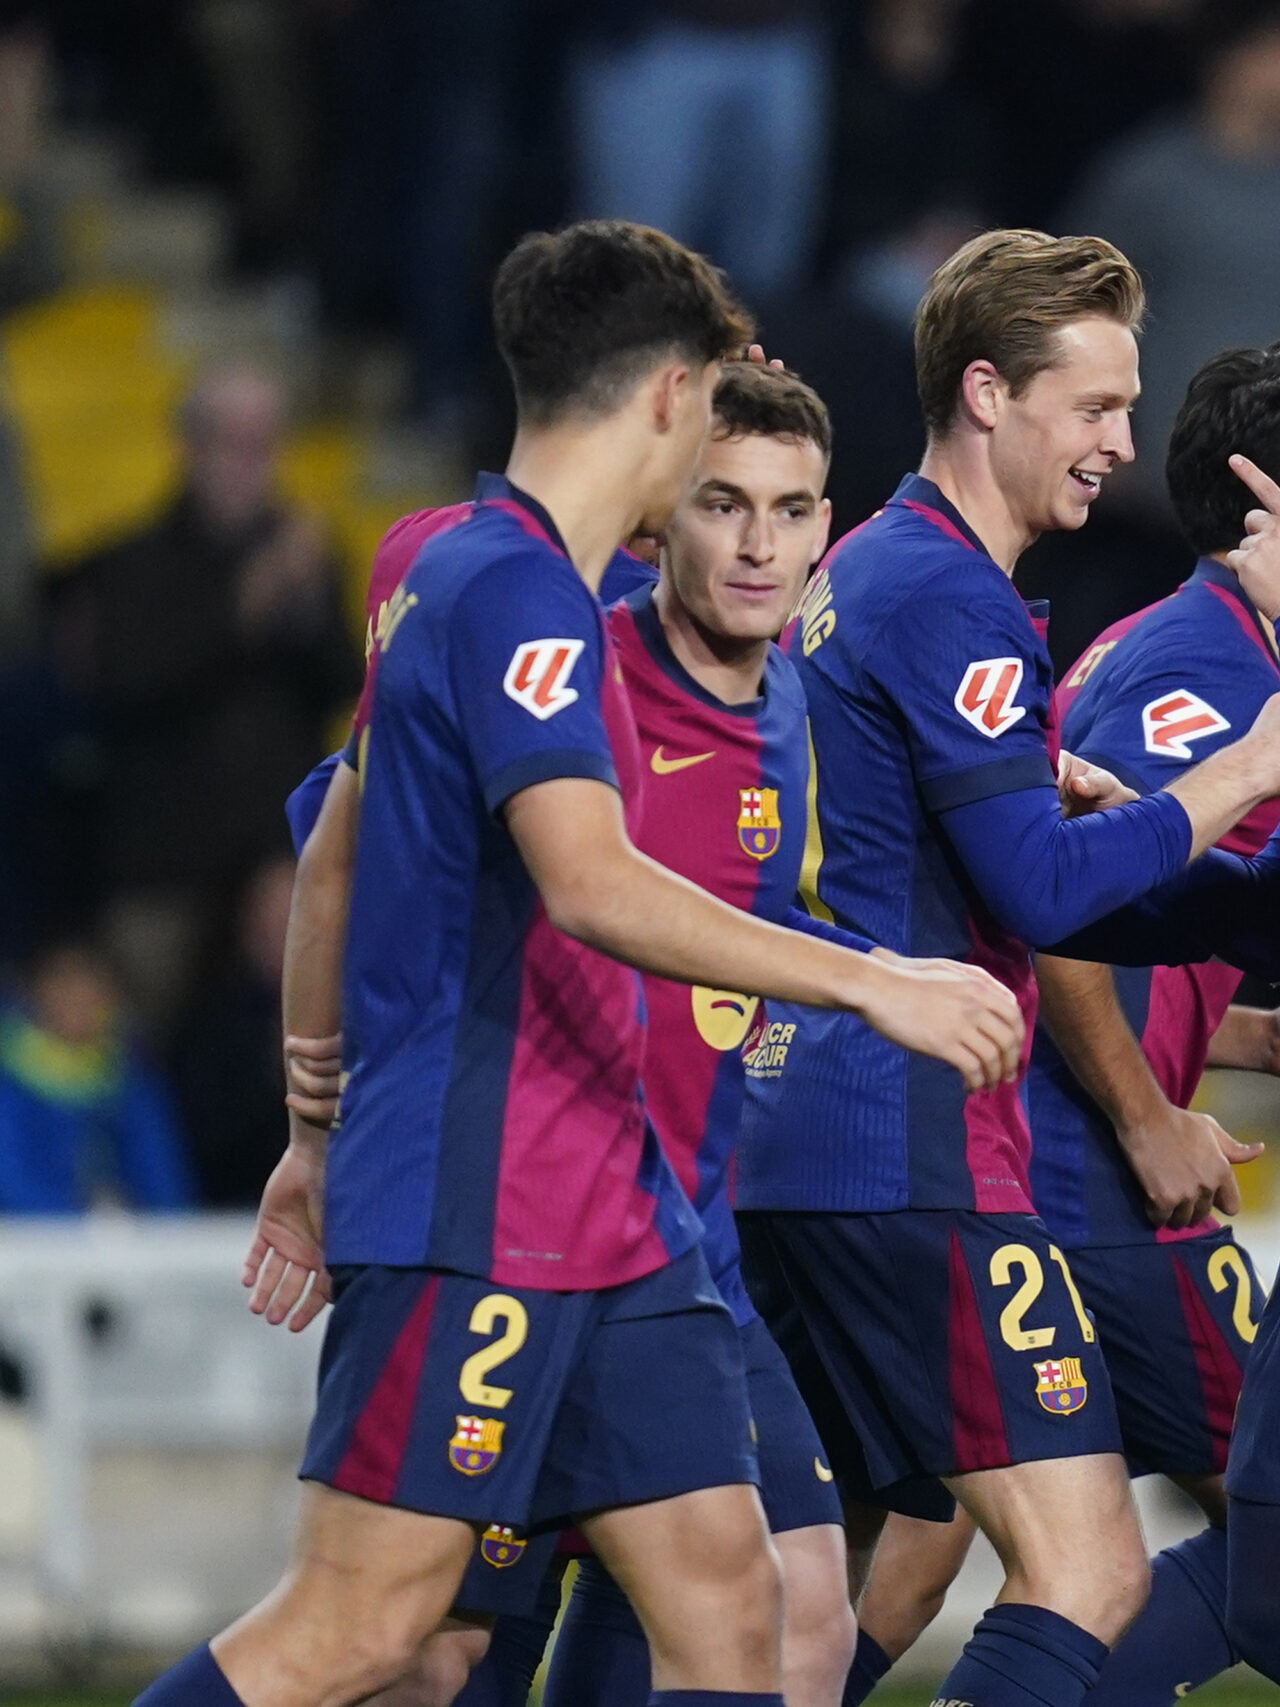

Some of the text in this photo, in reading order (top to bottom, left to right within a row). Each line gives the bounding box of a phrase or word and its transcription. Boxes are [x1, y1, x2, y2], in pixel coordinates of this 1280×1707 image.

[989, 1243, 1095, 1351] 21
[1207, 1245, 1269, 1344] 2
[459, 1294, 529, 1409] 2
[1051, 1380, 1073, 1390] FCB
